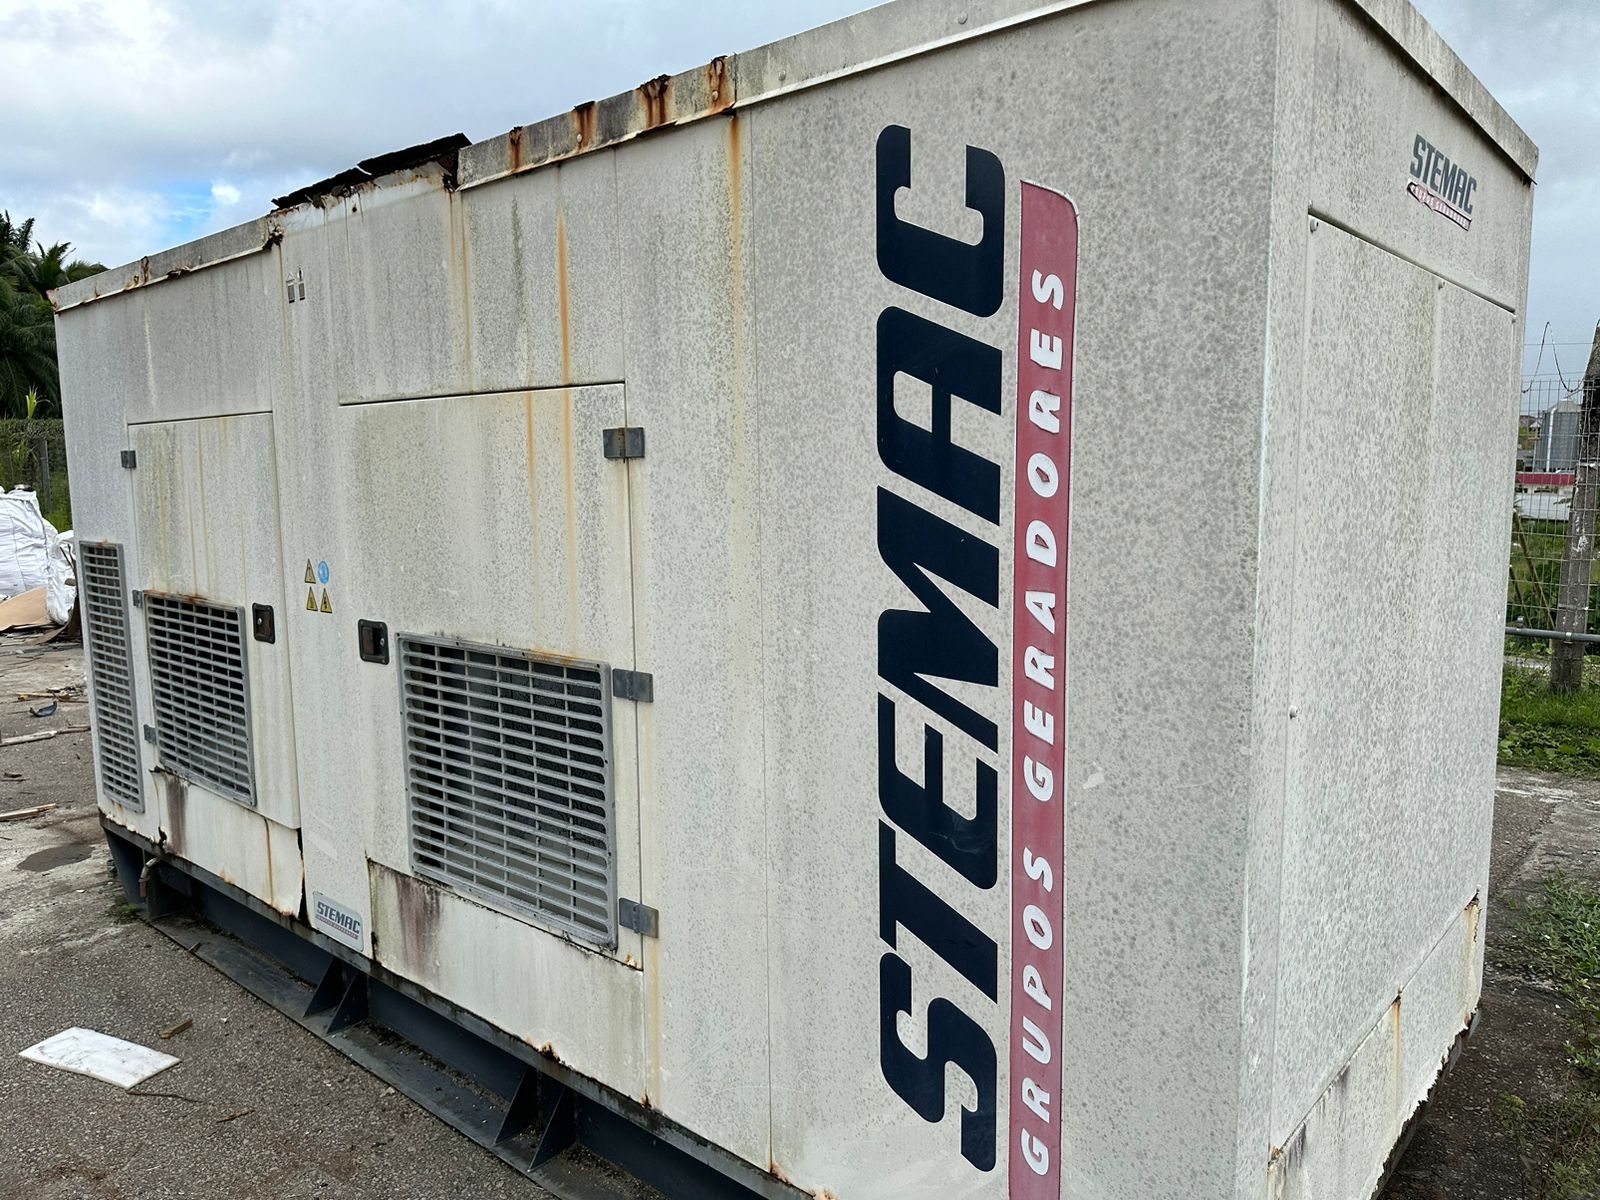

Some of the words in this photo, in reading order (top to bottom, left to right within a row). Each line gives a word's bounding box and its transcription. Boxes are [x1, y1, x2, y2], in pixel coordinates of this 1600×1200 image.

[1410, 133, 1477, 214] STEMAC
[876, 124, 1005, 1172] STEMAC
[1023, 269, 1064, 802] GERADORES
[317, 901, 361, 934] STEMAC
[1020, 847, 1055, 1176] GRUPOS
